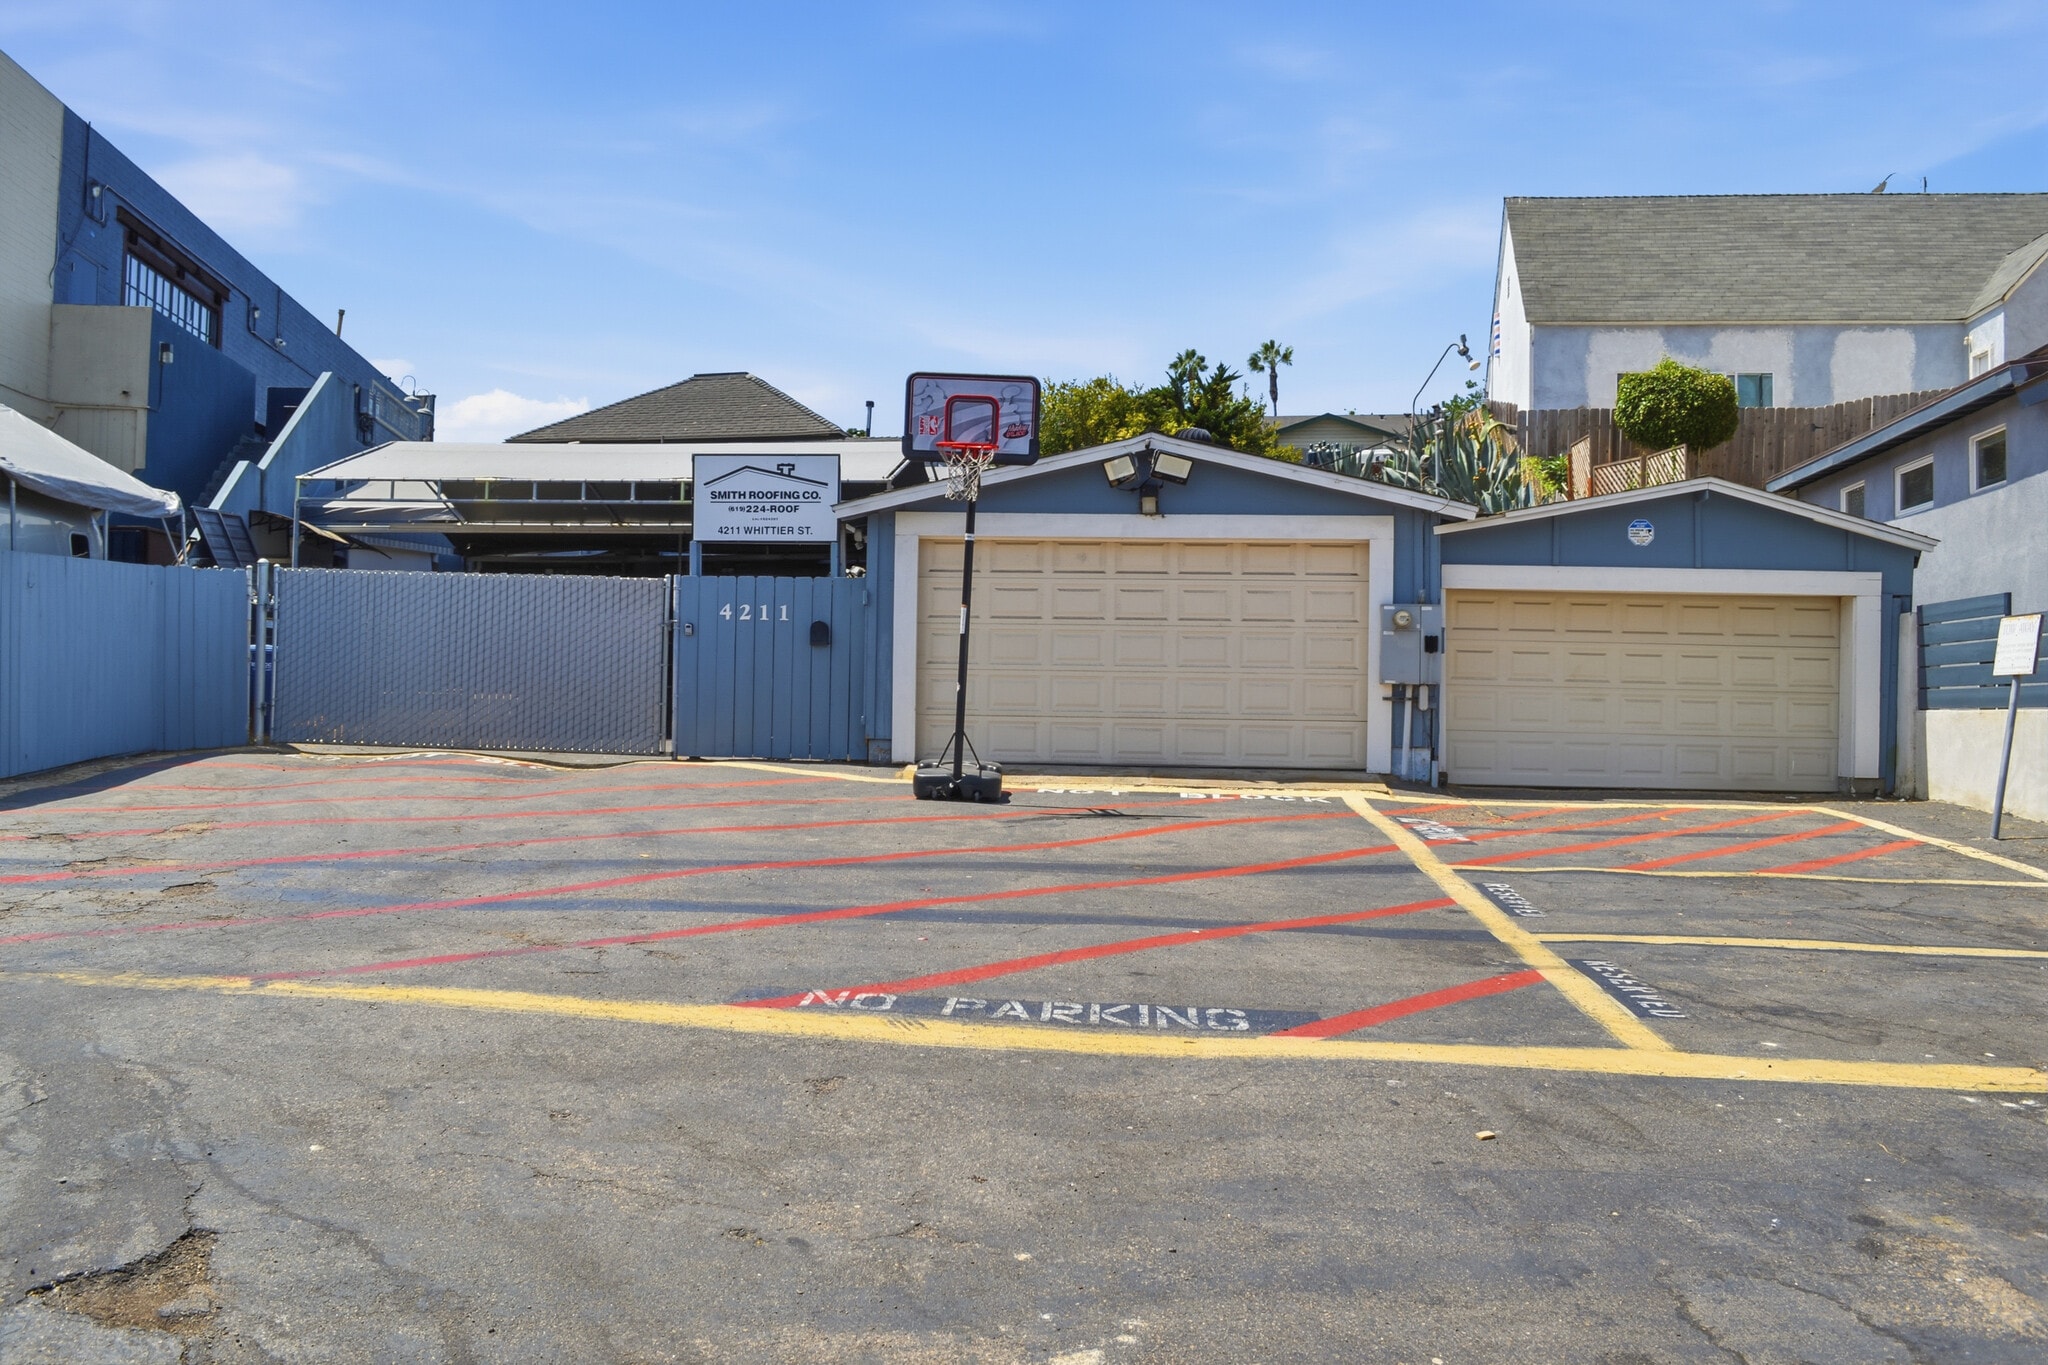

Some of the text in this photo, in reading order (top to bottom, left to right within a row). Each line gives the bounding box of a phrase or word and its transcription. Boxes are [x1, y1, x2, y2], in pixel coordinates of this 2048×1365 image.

[710, 490, 821, 500] SMITH ROOFING CO.
[717, 526, 813, 535] 4211 WHITTIER ST.
[720, 603, 789, 621] 4211
[799, 989, 1249, 1031] NO PARKING
